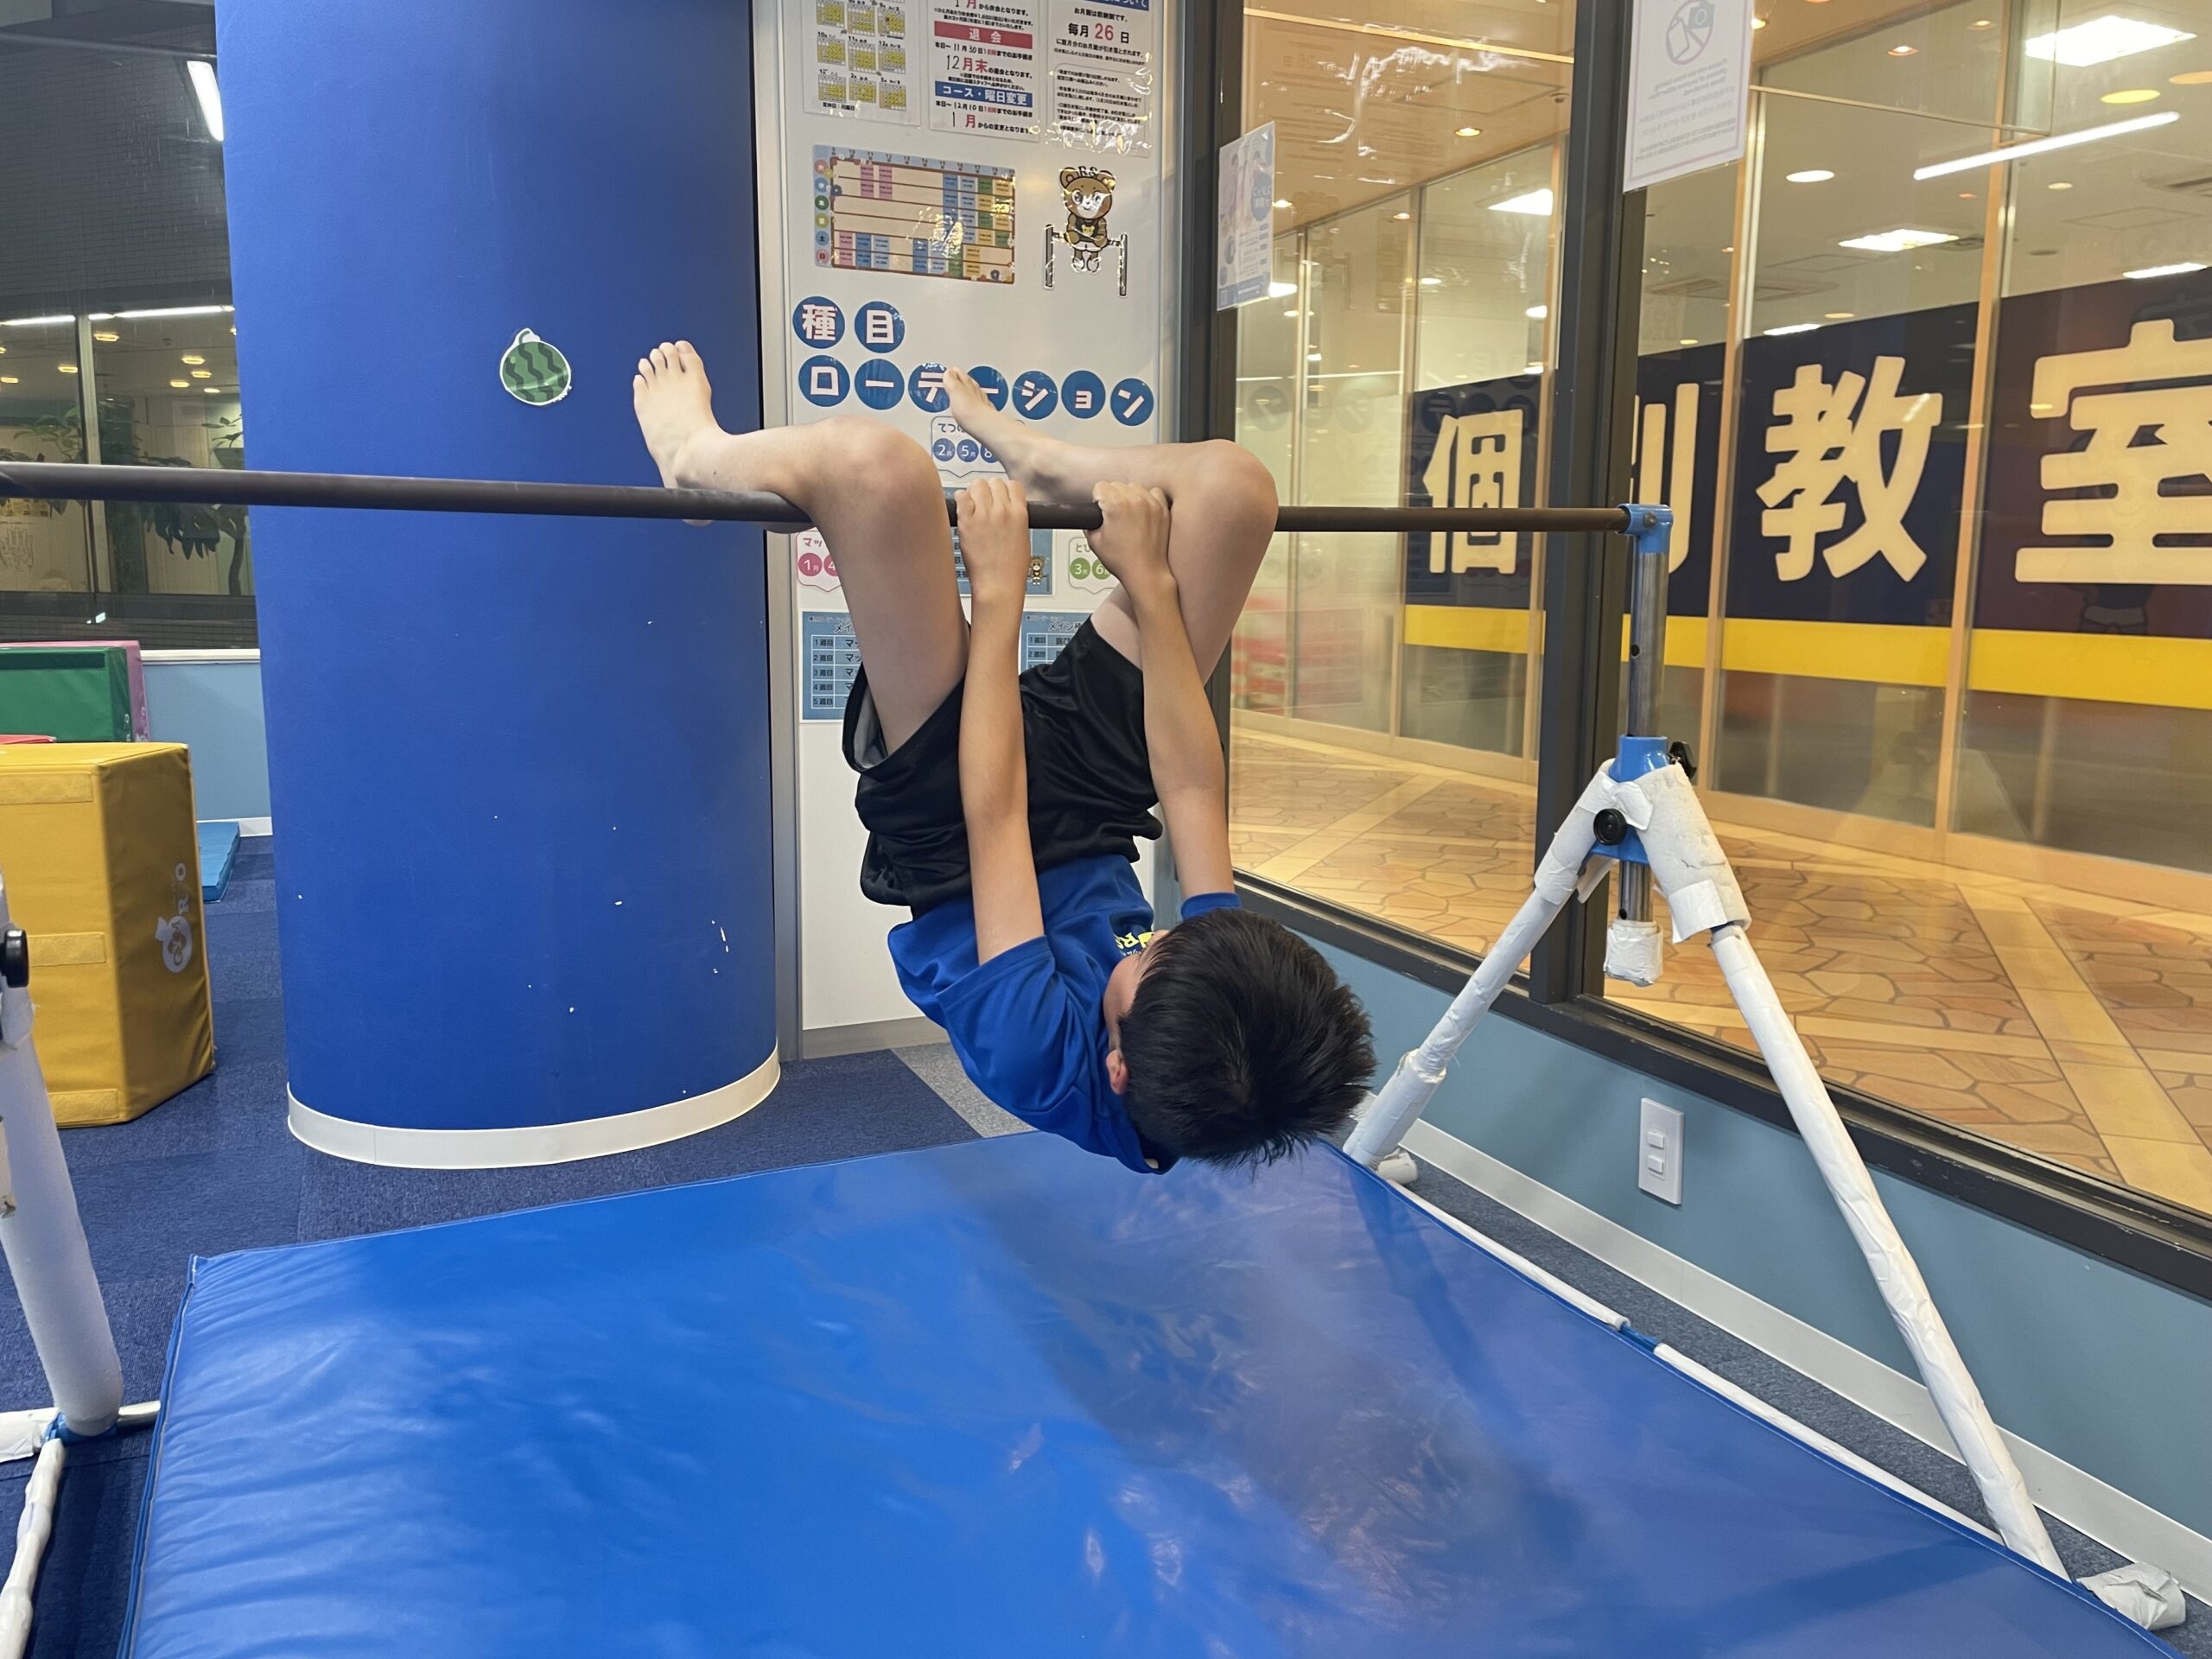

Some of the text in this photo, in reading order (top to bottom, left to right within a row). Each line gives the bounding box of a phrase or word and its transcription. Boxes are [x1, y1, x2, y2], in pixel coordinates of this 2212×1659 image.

[943, 86, 1027, 105] コース・曜日変更
[802, 303, 894, 345] 種目
[810, 366, 1145, 419] ローテーション
